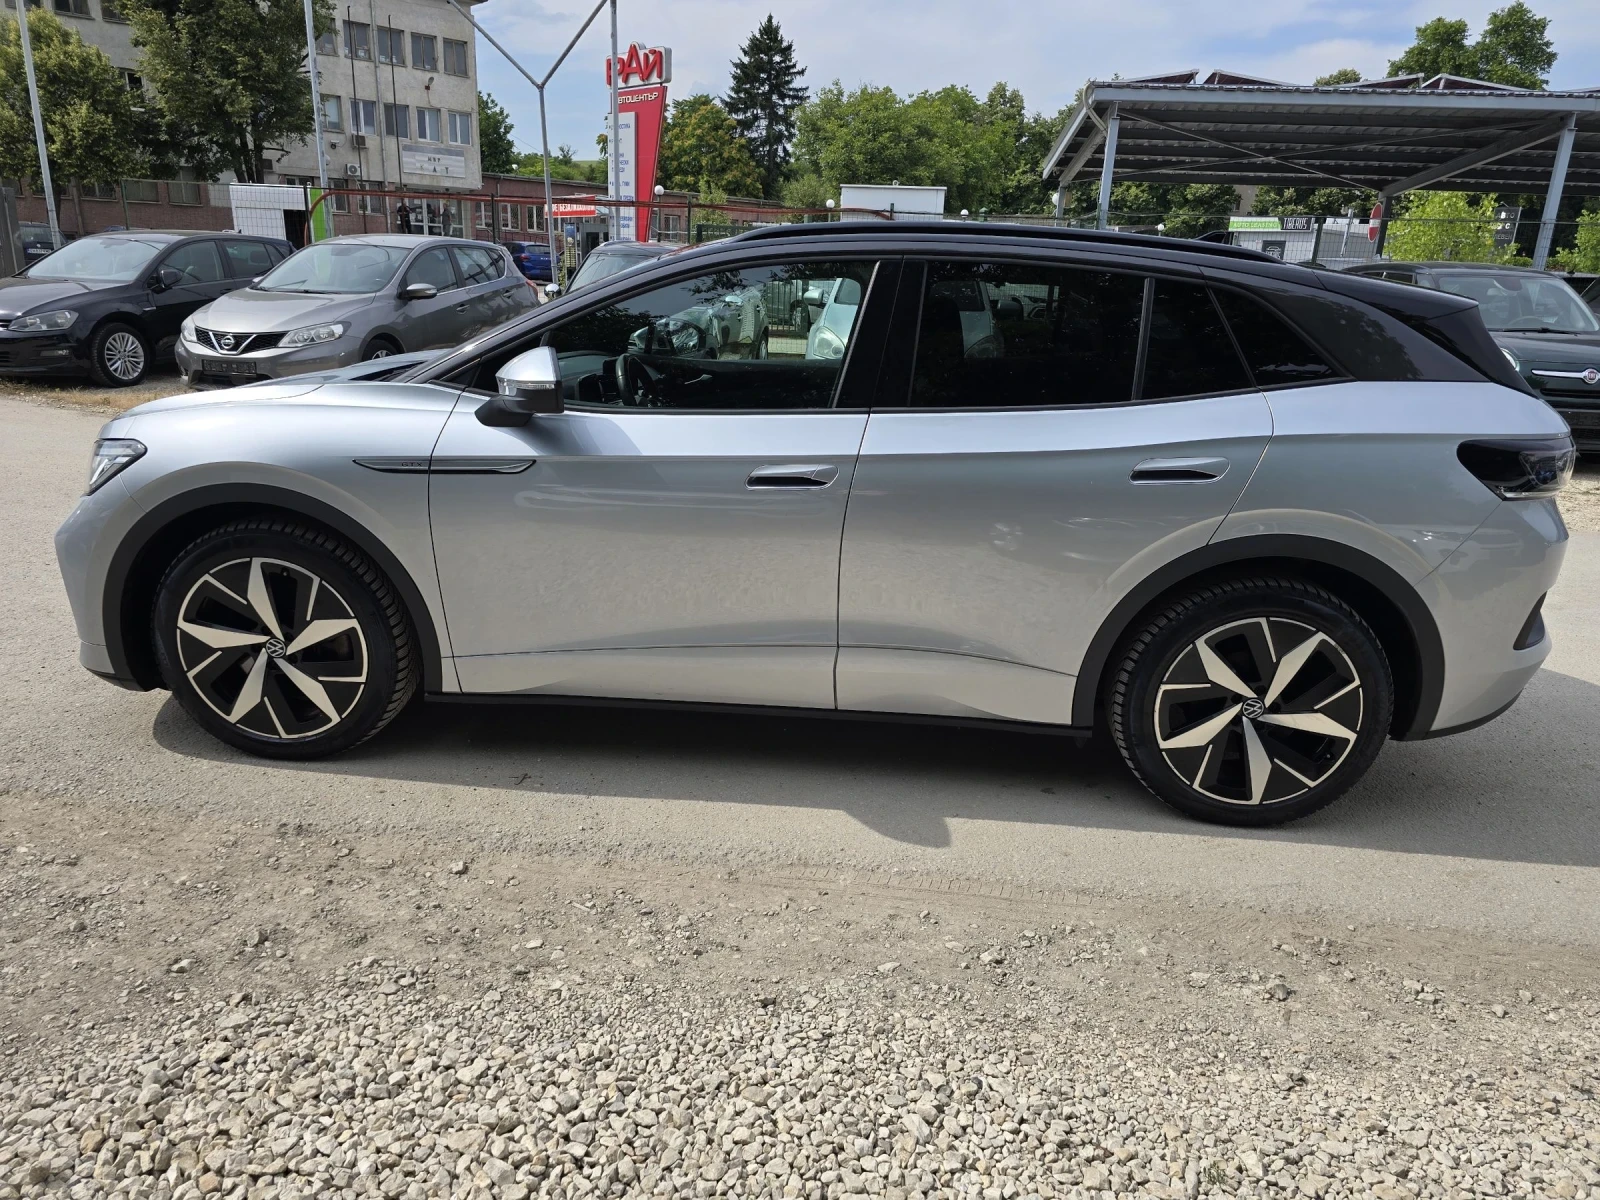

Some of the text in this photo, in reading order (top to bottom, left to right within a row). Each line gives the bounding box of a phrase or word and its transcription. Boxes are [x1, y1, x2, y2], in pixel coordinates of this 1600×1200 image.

[606, 44, 663, 86] РАЙ
[617, 92, 658, 104] ВТОЦЕНТЪР
[1233, 221, 1249, 230] AUTO
[1250, 221, 1278, 230] LEASING
